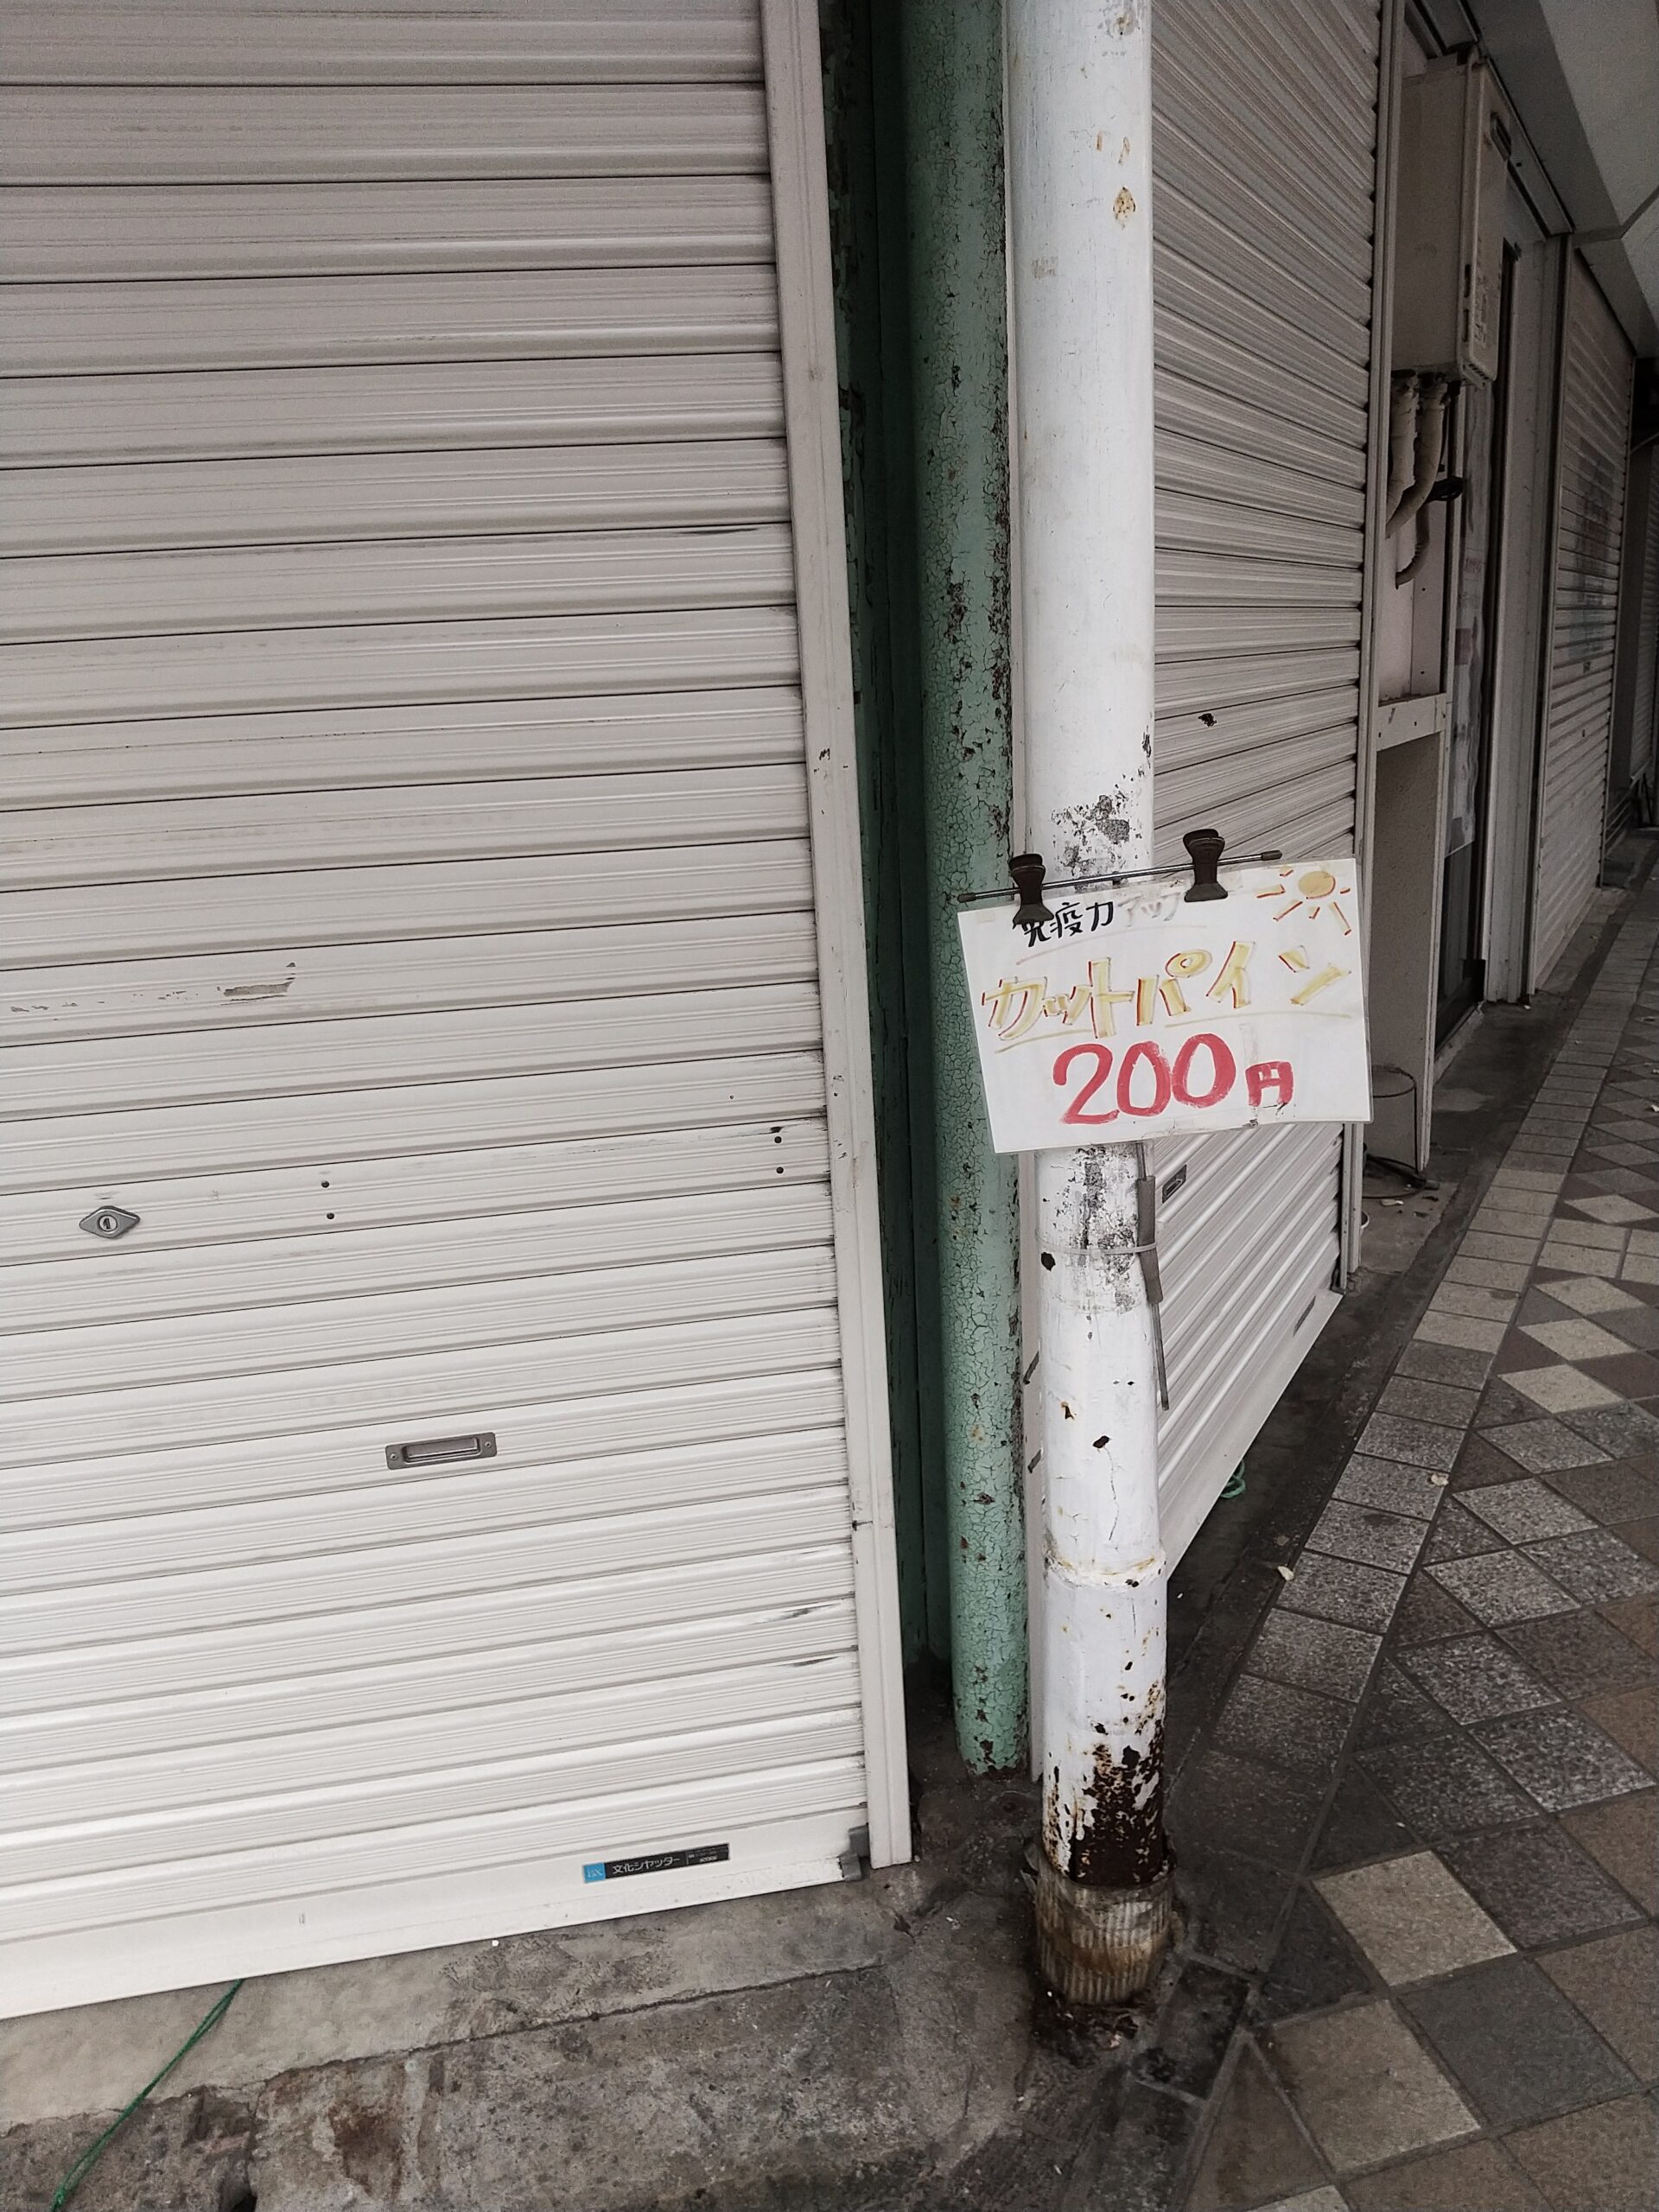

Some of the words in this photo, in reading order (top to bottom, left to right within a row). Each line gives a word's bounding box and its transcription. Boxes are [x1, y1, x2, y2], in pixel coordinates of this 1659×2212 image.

[982, 940, 1352, 1040] カットパイン
[1052, 1033, 1294, 1124] 200円
